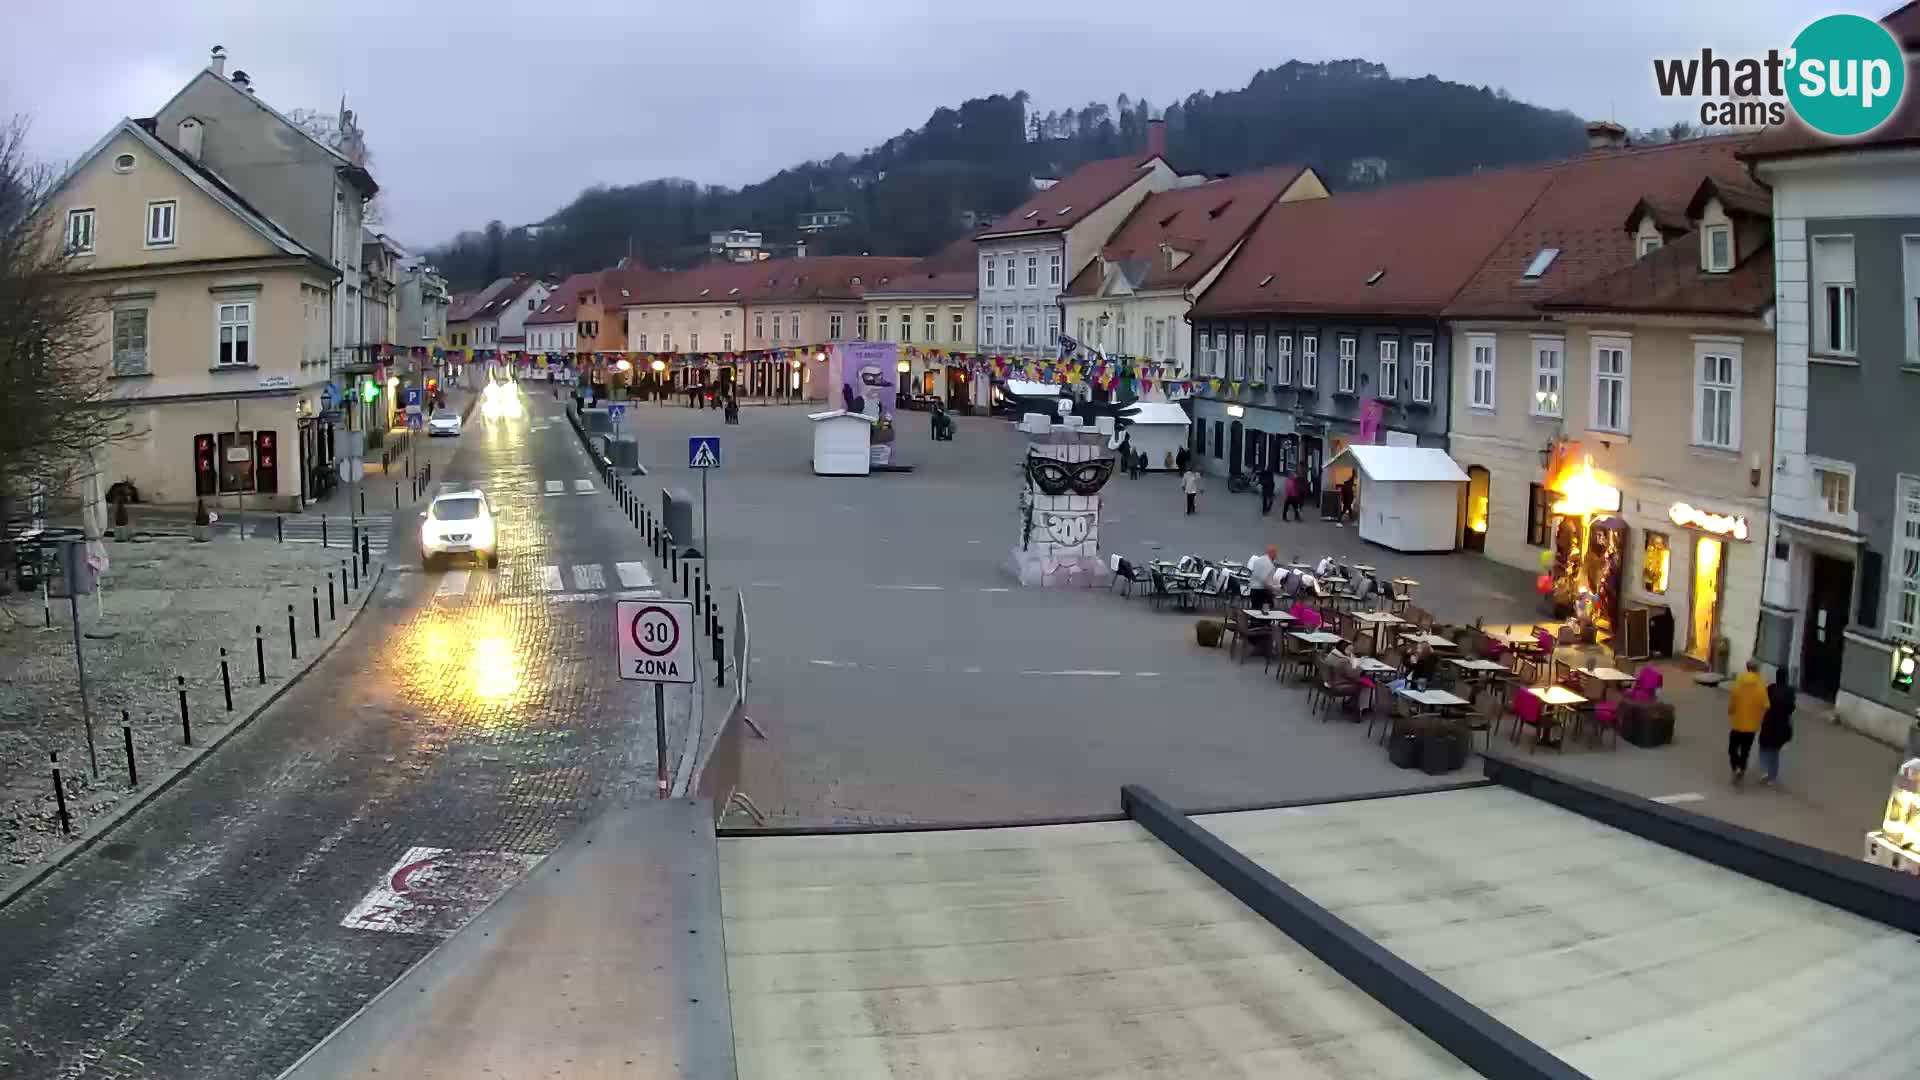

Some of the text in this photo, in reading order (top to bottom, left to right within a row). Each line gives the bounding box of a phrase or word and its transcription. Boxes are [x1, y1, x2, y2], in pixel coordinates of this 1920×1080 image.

[409, 391, 417, 402] P
[1048, 515, 1088, 545] 200
[644, 622, 668, 643] 30
[634, 659, 679, 676] ZONA
